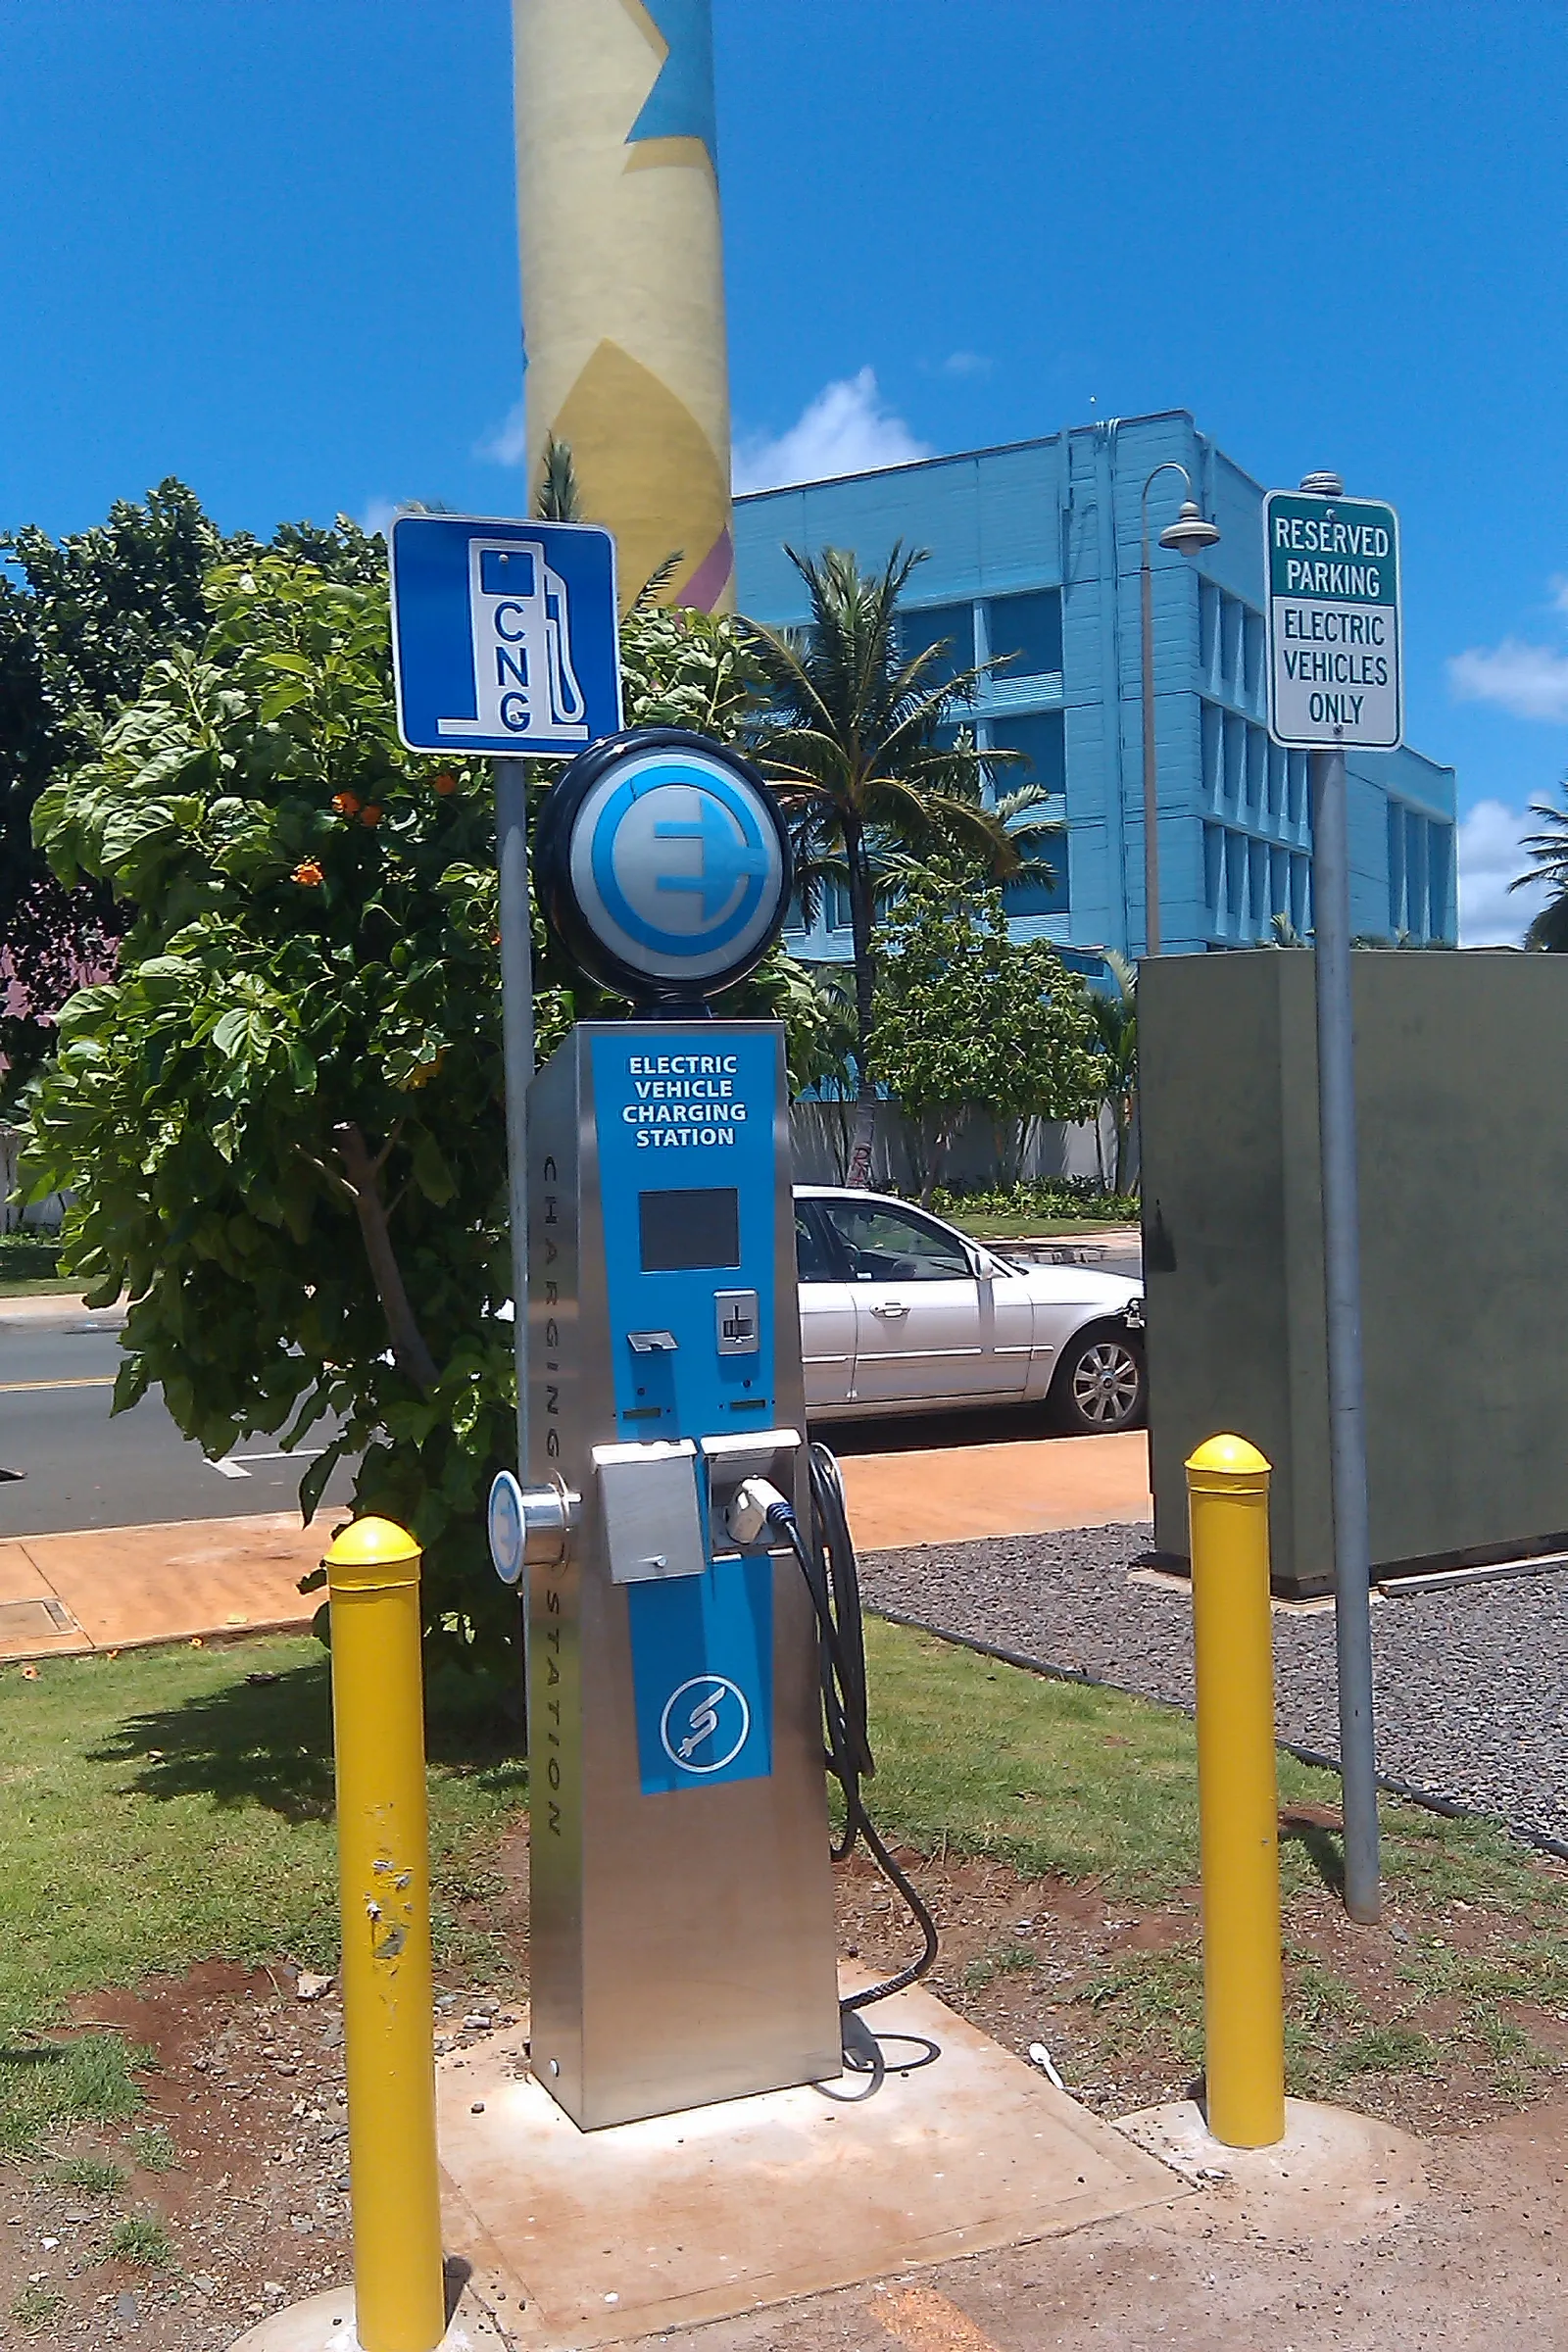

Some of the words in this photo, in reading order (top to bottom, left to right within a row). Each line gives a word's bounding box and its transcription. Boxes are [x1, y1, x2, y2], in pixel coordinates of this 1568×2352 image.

[1275, 517, 1389, 558] RESERVED
[1287, 560, 1380, 598] PARKING
[1284, 609, 1385, 647] ELECTRIC
[494, 602, 531, 733] CNG
[1284, 650, 1388, 687] VEHICLES
[1309, 692, 1364, 724] ONLY
[629, 1055, 737, 1074] ELECTRIC
[635, 1080, 733, 1099] VEHICLE
[622, 1103, 746, 1123] CHARGING
[637, 1128, 734, 1147] STATION
[544, 1154, 561, 1458] CHARGING
[546, 1590, 561, 1837] STATION
